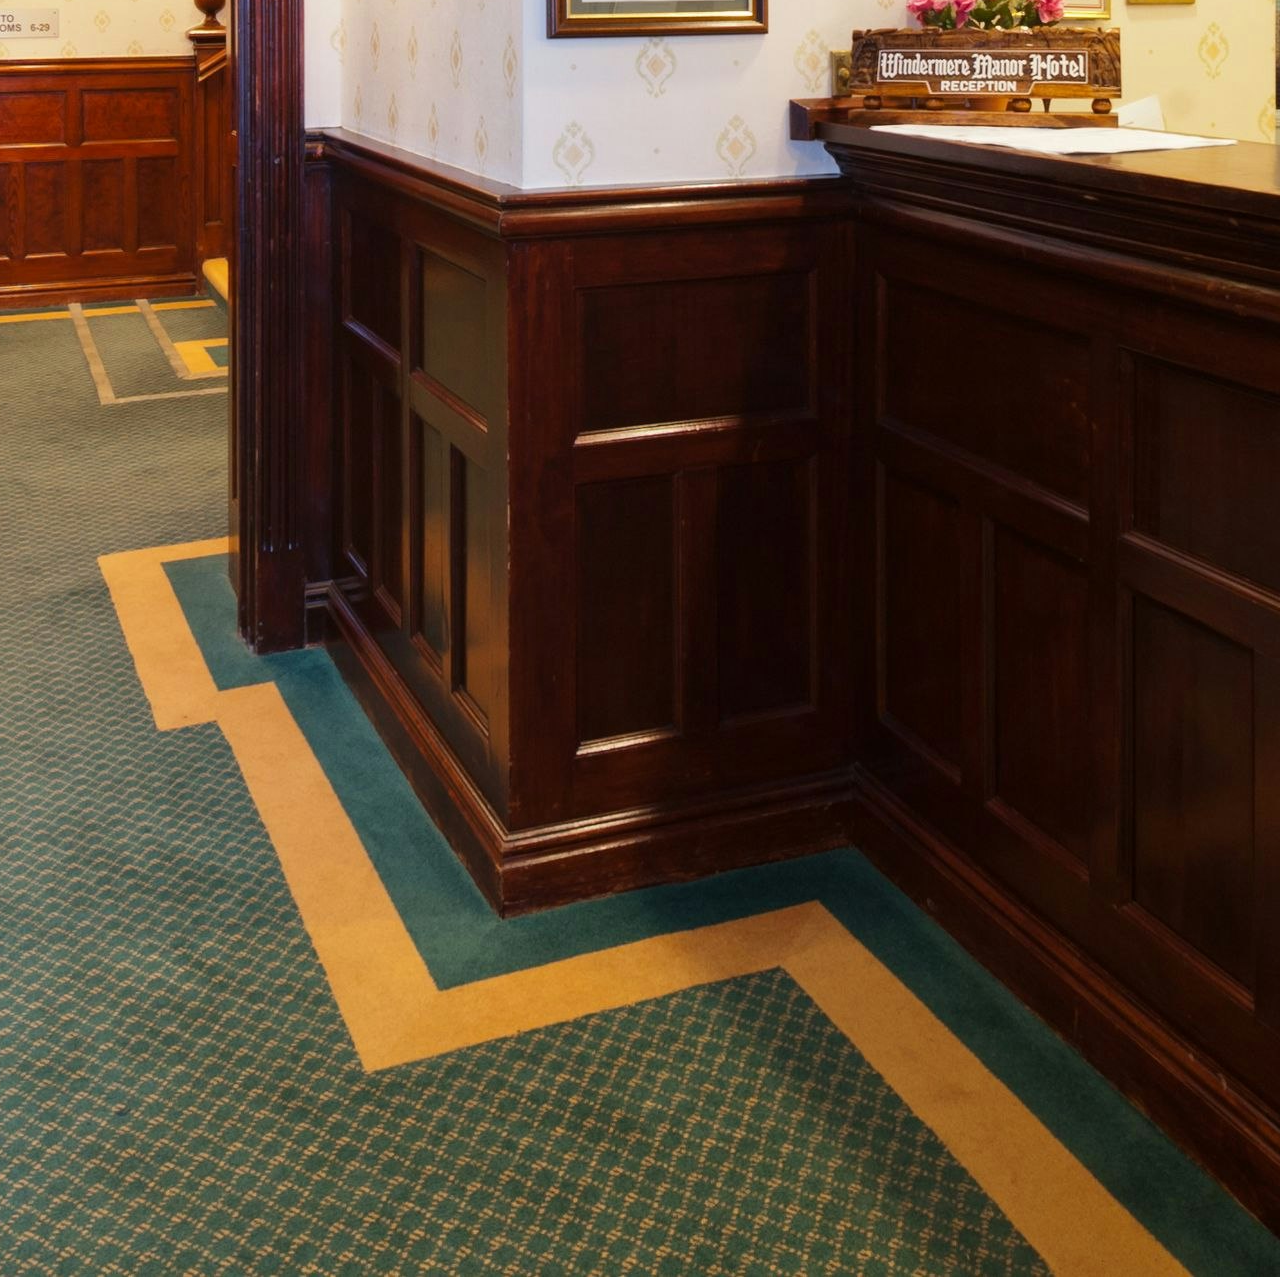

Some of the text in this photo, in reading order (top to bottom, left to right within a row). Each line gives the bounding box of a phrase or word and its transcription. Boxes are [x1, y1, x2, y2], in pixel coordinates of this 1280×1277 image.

[0, 14, 15, 23] TO
[30, 23, 50, 32] 6-29
[880, 53, 1085, 80] Windermere Manor Hotel
[940, 80, 1017, 92] RECEPTION
